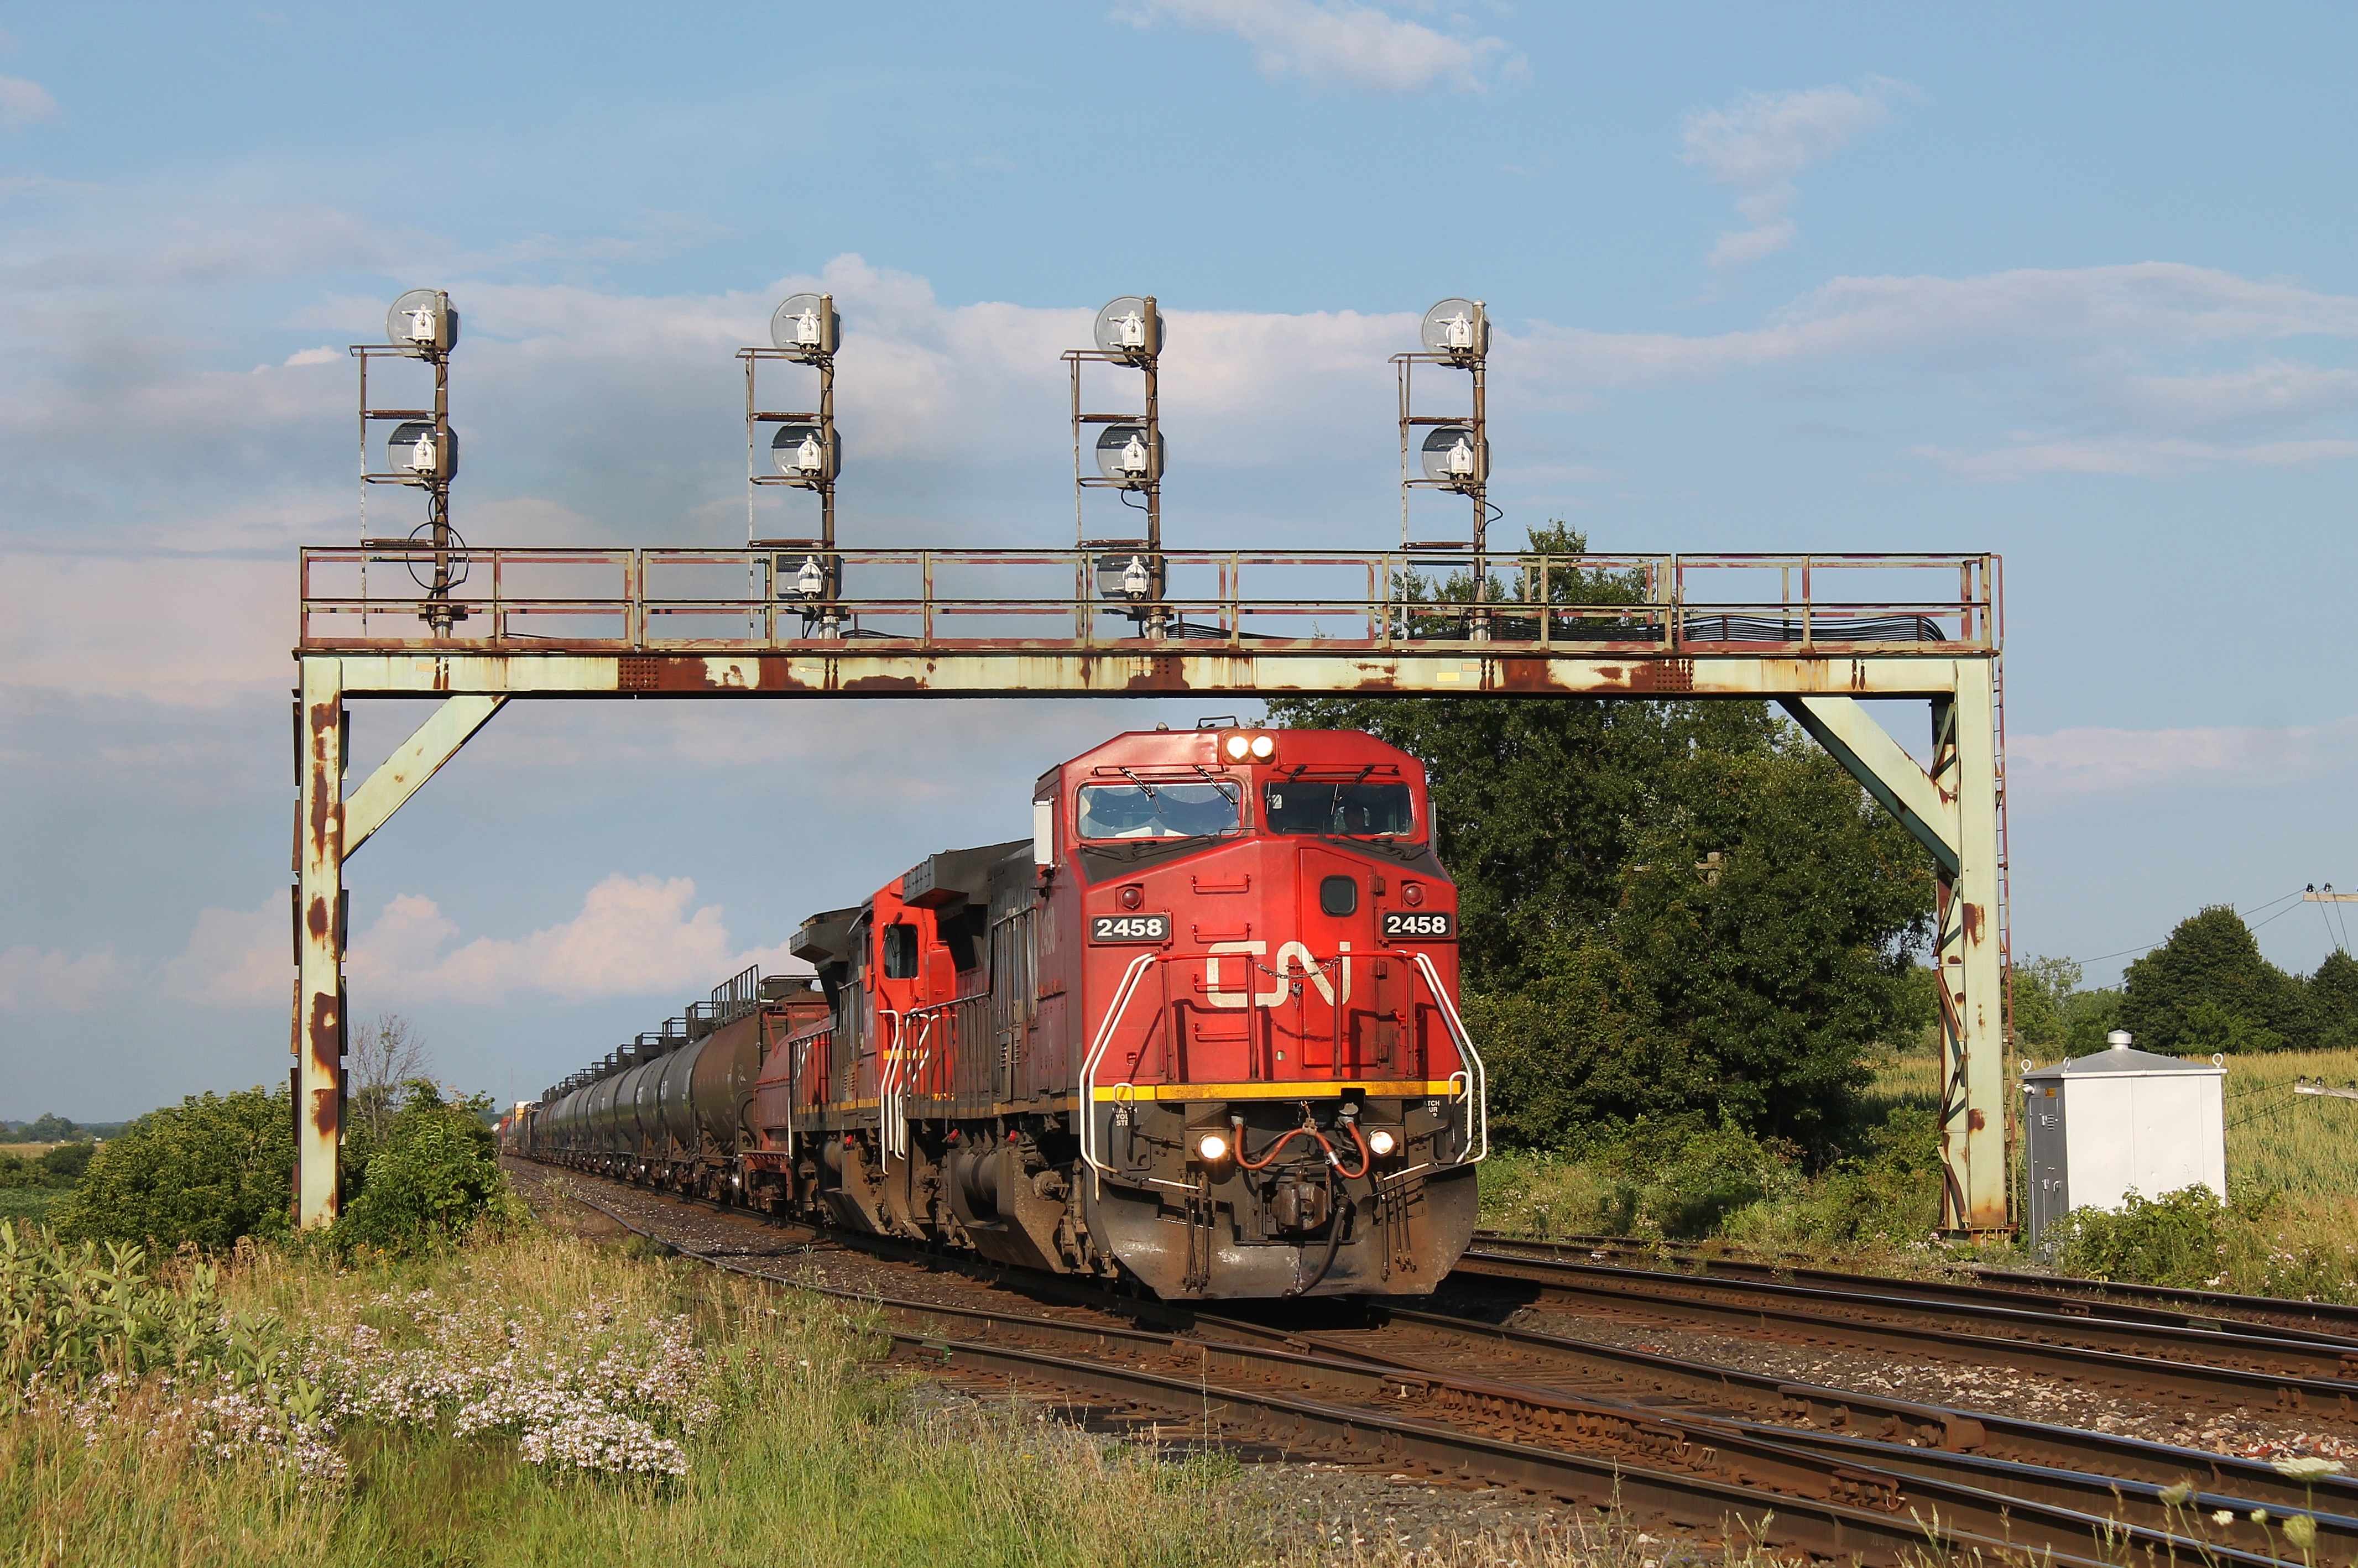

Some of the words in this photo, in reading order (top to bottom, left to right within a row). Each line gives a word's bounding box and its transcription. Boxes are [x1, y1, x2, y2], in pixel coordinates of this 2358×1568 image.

[1097, 918, 1162, 937] 2458
[1387, 916, 1446, 934] 2458
[1206, 940, 1351, 1007] CN
